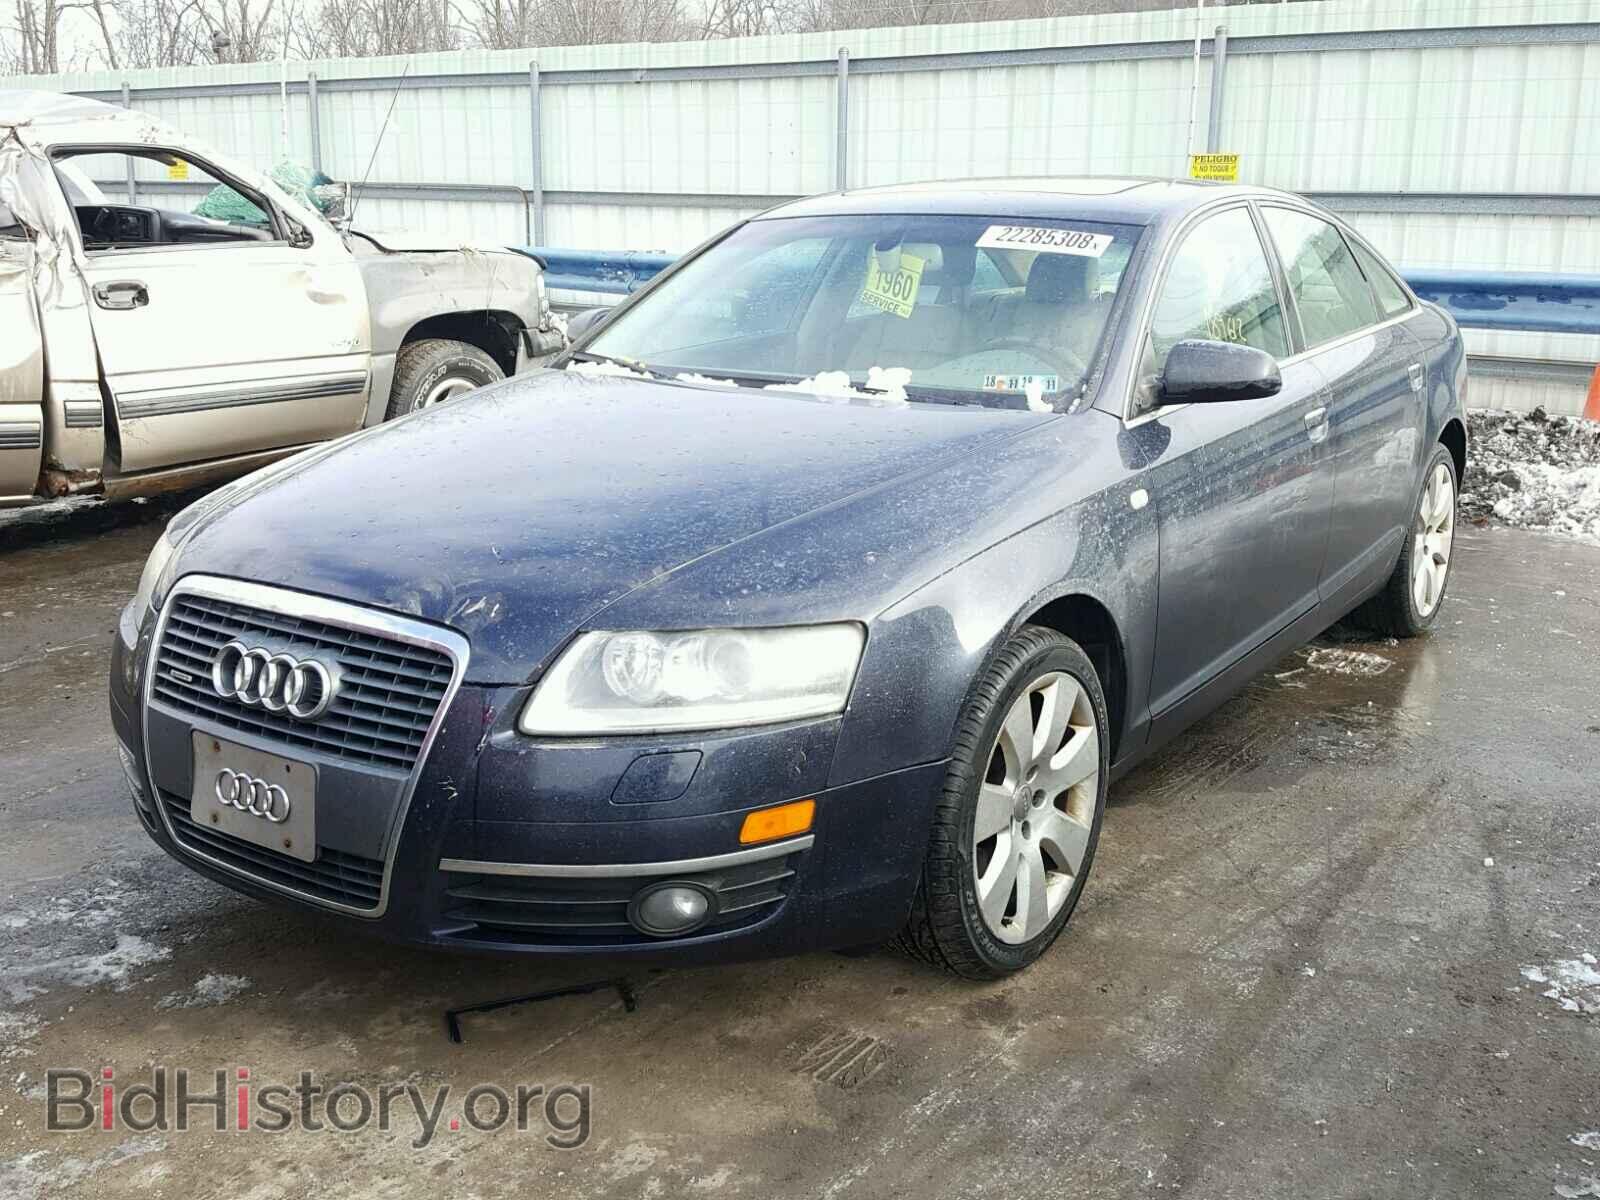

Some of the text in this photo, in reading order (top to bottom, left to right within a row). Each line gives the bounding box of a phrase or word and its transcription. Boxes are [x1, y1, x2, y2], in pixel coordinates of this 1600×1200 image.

[1194, 154, 1238, 163] PELIGRO
[995, 227, 1094, 249] 22285308
[862, 291, 900, 313] SERVICE
